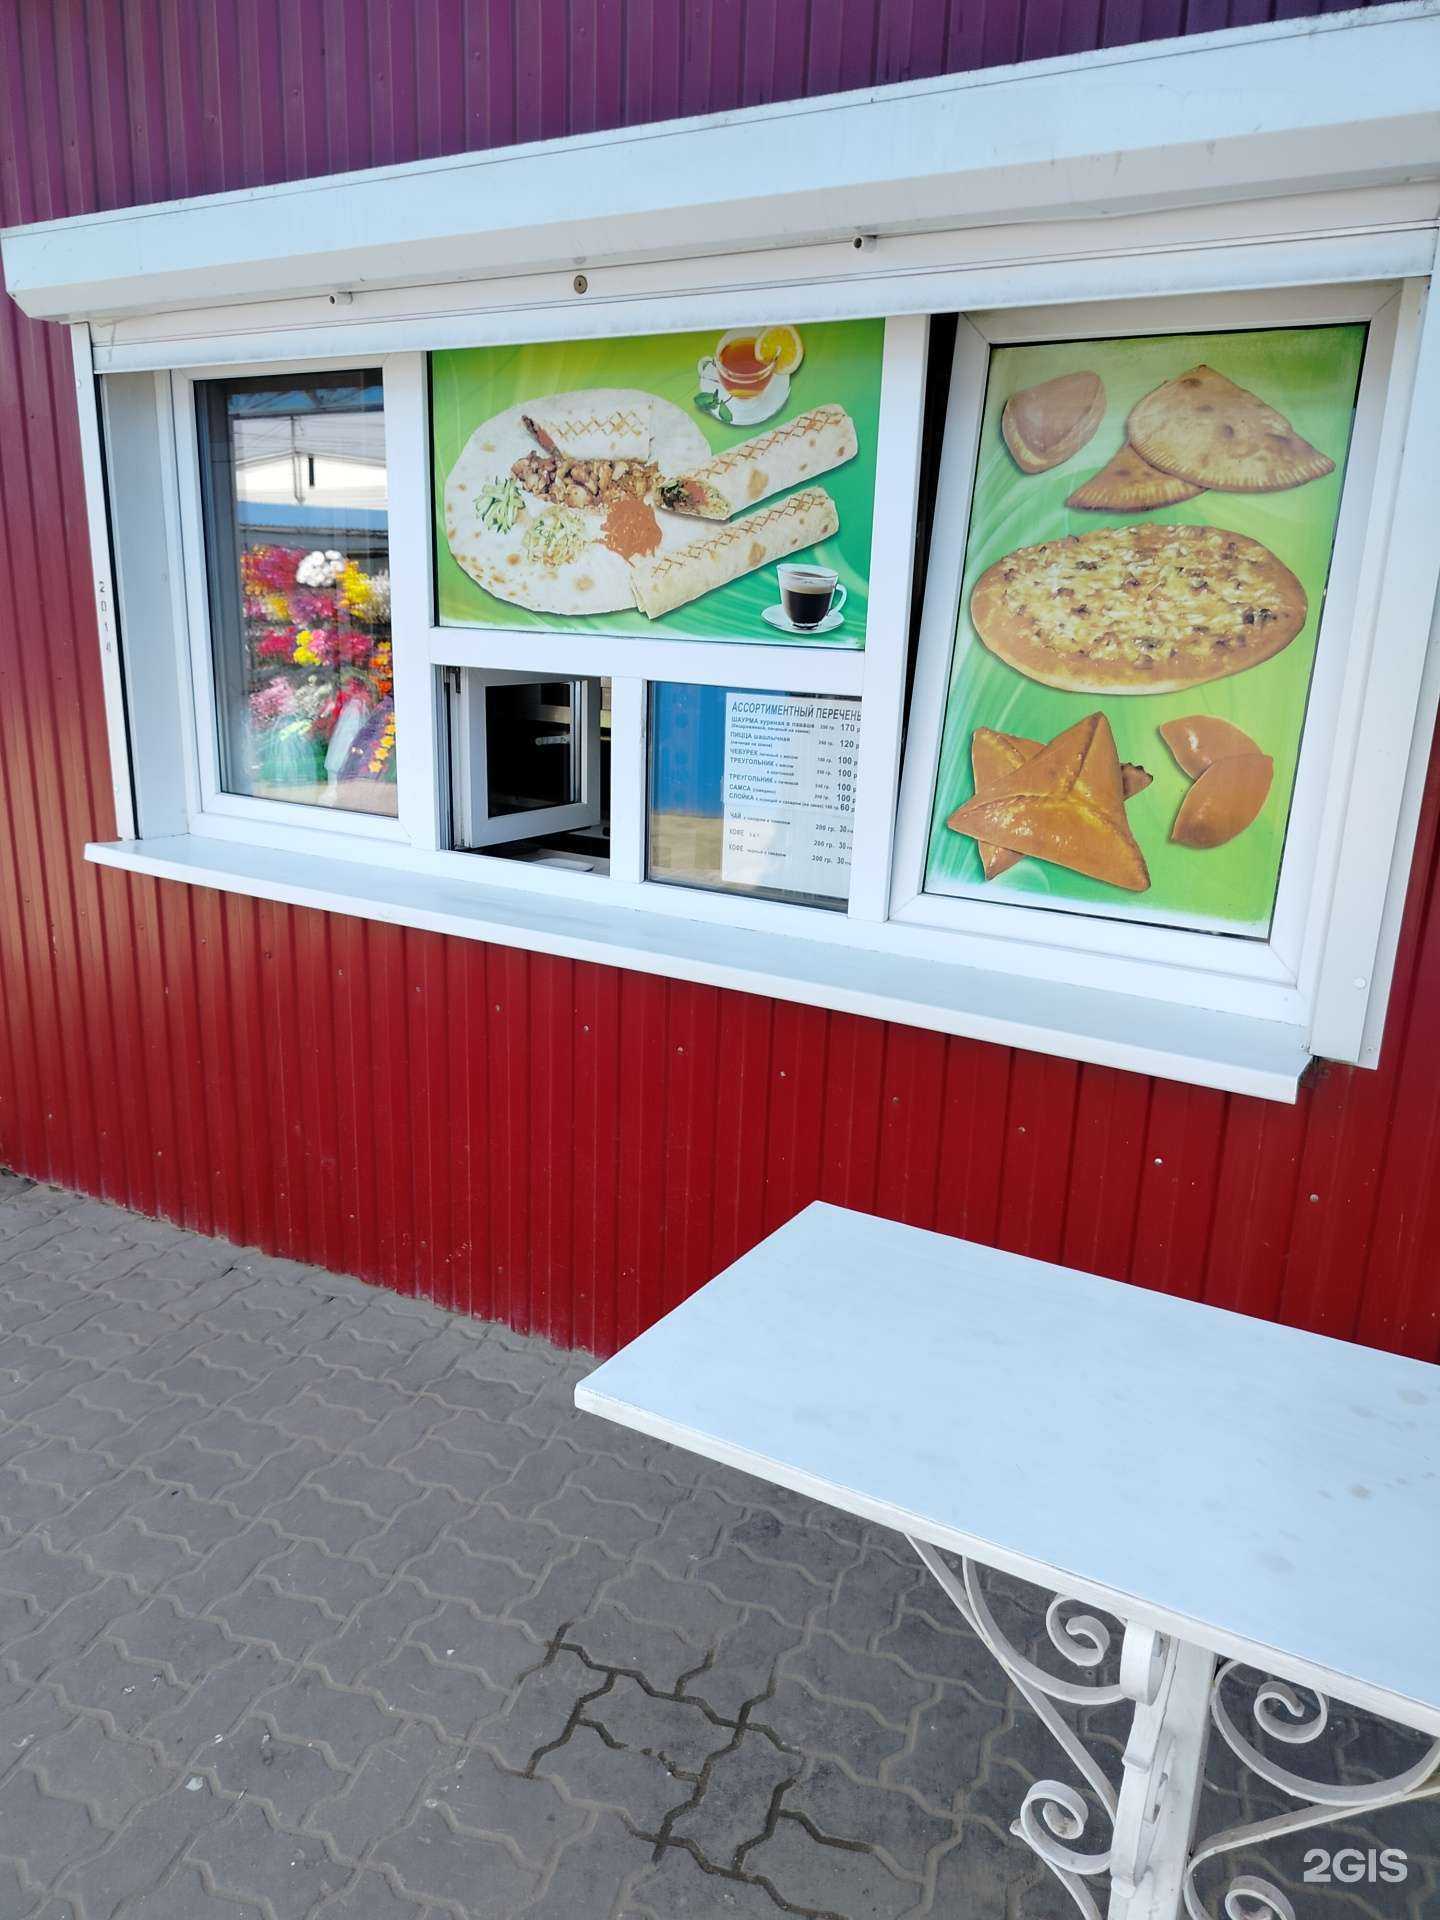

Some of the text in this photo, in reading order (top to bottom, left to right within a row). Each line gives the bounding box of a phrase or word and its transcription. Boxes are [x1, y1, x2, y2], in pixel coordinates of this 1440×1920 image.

[732, 701, 861, 722] АССОРТИМЕНТНЫЙ ПЕРЕЧЕНЬ
[732, 716, 758, 725] ШАУРМА
[841, 723, 855, 732] 170
[730, 731, 752, 739] ПИЦЦА
[840, 739, 854, 748] 120
[730, 748, 757, 756] ЧЕБУРЕК
[730, 757, 775, 766] ТРЕУГОЛЬНИК
[838, 756, 852, 765] 100
[729, 773, 774, 783] ТРЕУГОЛЬНИК
[838, 769, 852, 778] 100
[838, 782, 851, 791] 100
[729, 792, 755, 801] СЛОЙКА
[840, 803, 850, 812] 60
[837, 793, 851, 802] 100
[814, 839, 824, 847] 200
[839, 842, 846, 850] 30
[811, 854, 823, 862] 200
[837, 856, 844, 865] 30
